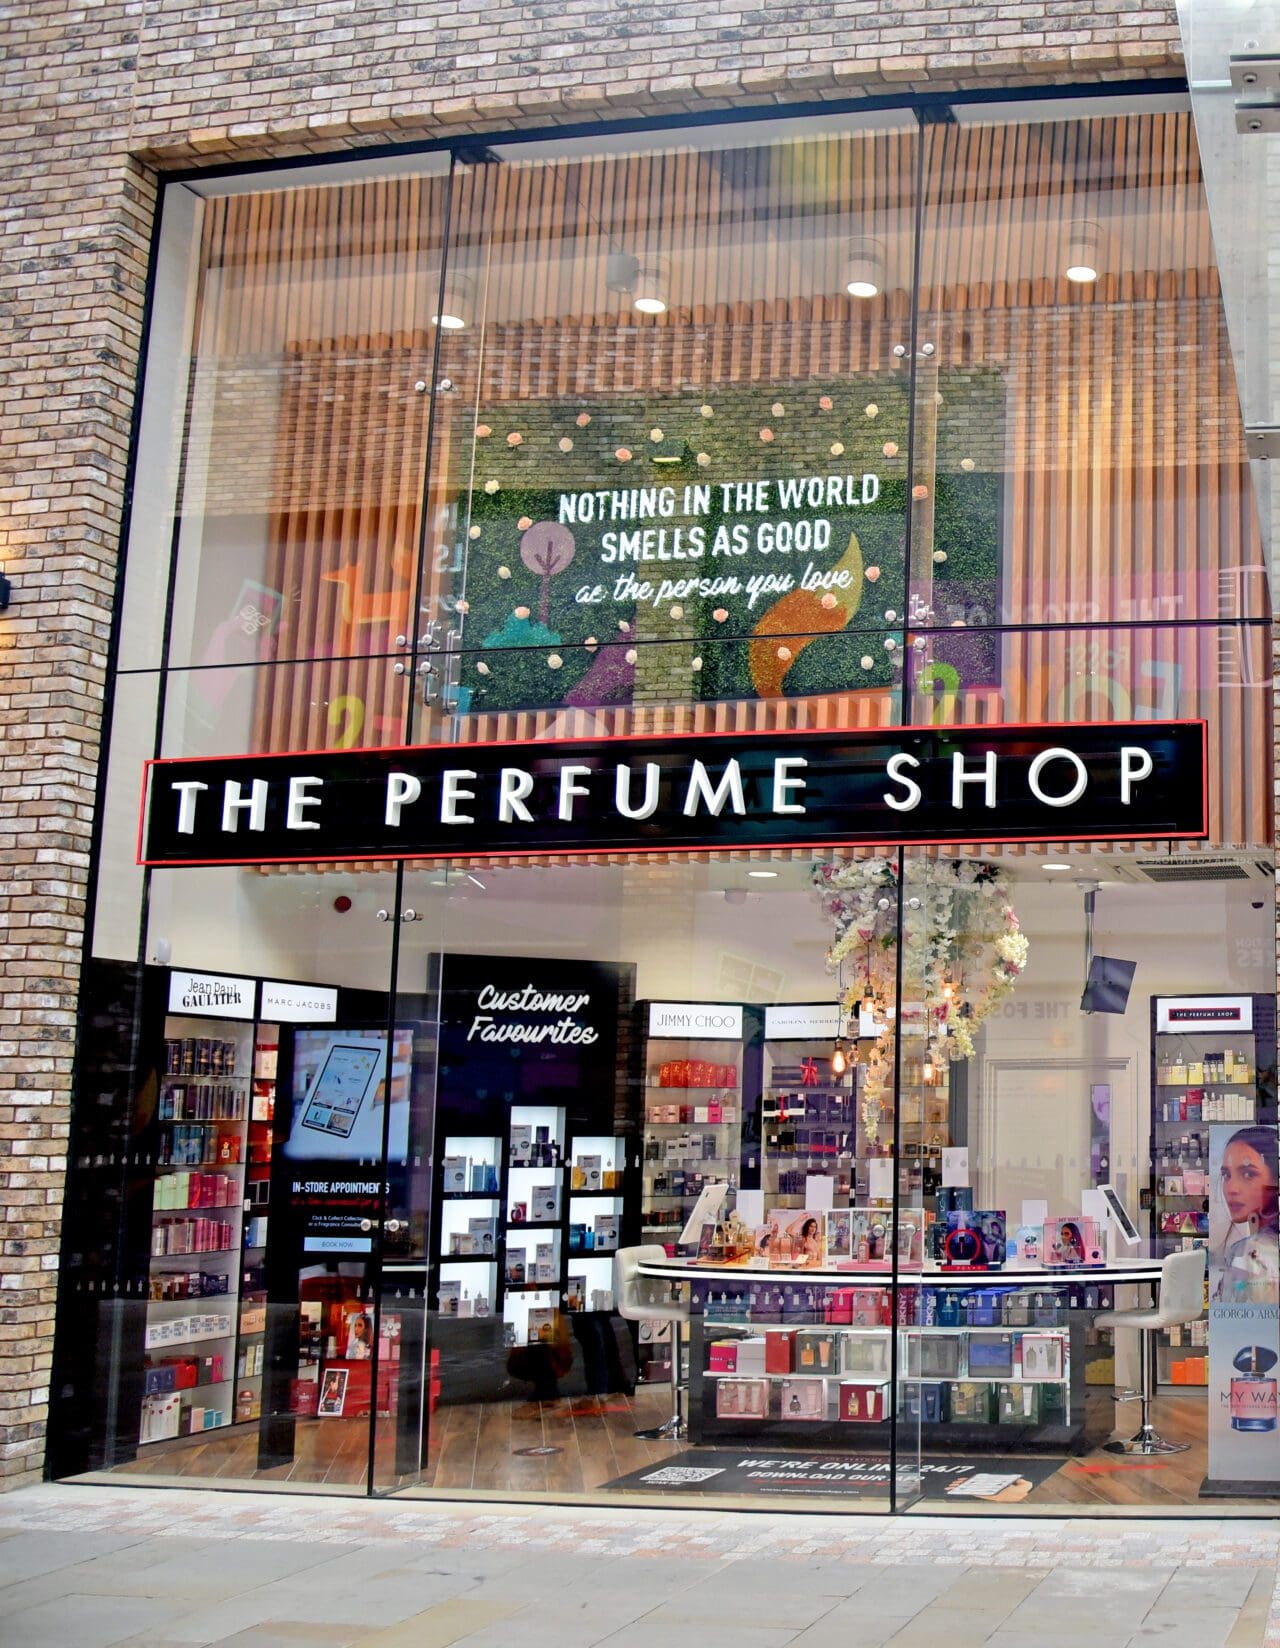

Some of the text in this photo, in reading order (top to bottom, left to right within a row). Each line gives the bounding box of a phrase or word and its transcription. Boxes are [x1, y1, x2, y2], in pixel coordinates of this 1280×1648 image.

[559, 474, 880, 524] NOTHING IN THE WORLD
[601, 519, 831, 562] SMELLS AS GOOD
[613, 573, 655, 602] the
[654, 575, 743, 607] person
[746, 571, 797, 609] you
[800, 562, 855, 590] love
[171, 747, 1153, 834] THE PERFUME SHOP
[188, 978, 238, 997] Jean Paul
[182, 992, 242, 1008] GAULTIER
[267, 998, 332, 1011] MARC JACOBS
[477, 983, 590, 1012] Customer
[466, 1015, 599, 1044] Favourites
[656, 1014, 736, 1028] JIMMY CHOO
[292, 1181, 391, 1194] IN-STORE APPOINTMENS
[926, 1292, 935, 1326] DKNY
[1213, 1308, 1255, 1320] GIORGIO
[1220, 1391, 1245, 1403] MY
[737, 1459, 818, 1469] WE'RE
[919, 1464, 976, 1474] 24/7
[746, 1470, 845, 1481] DOWNLOAD
[847, 1474, 887, 1482] OUR
